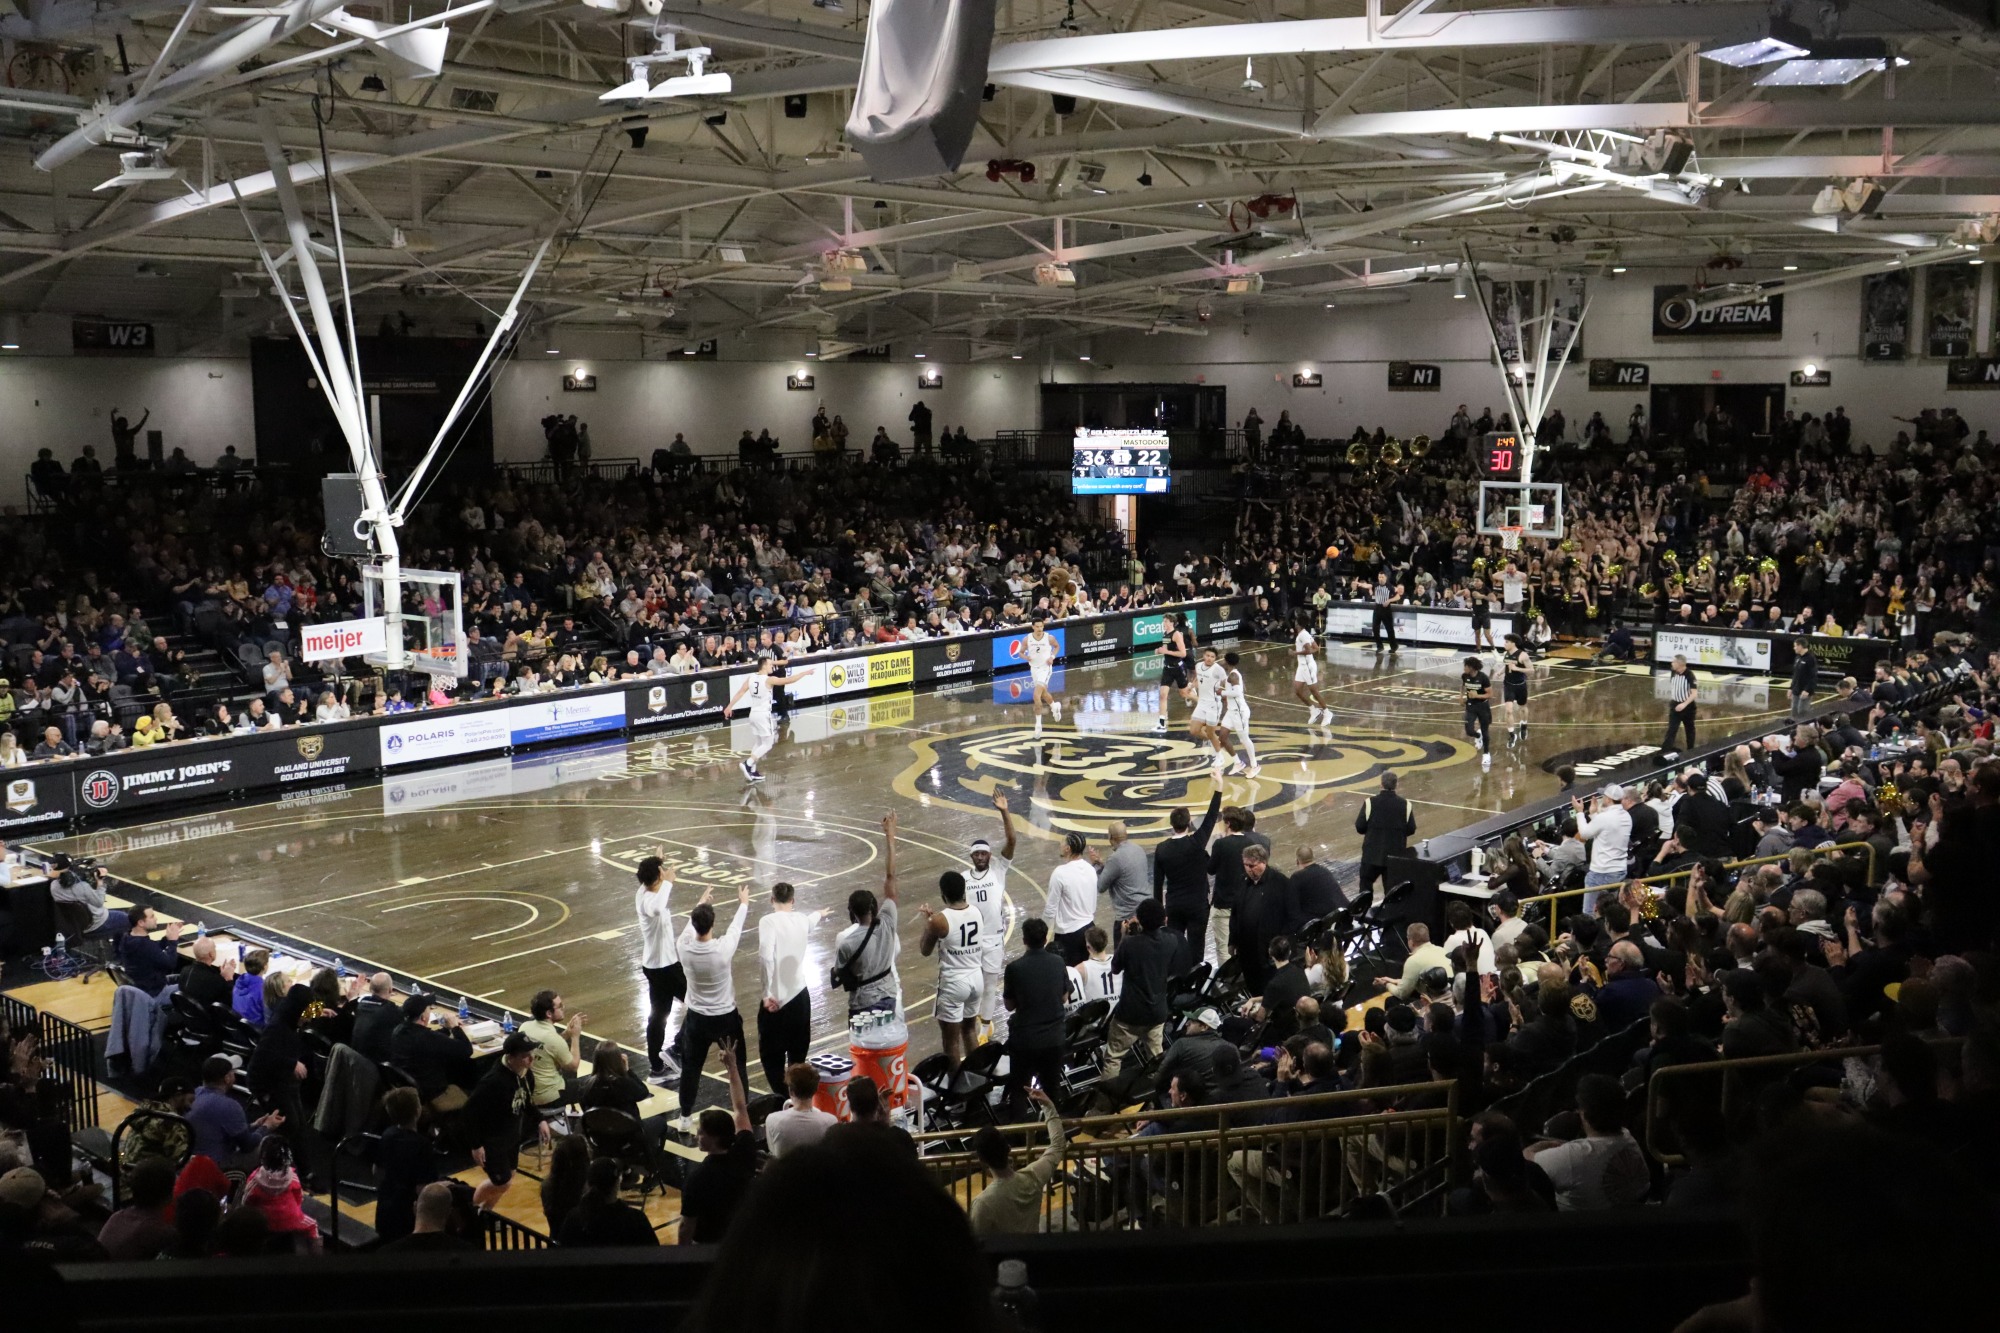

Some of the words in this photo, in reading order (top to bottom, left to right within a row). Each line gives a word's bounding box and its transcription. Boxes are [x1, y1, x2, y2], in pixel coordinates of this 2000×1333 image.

[108, 325, 147, 345] W3
[1502, 349, 1520, 361] 45
[1879, 343, 1891, 356] 5
[1945, 342, 1953, 355] 1
[1413, 369, 1434, 384] N1
[1617, 367, 1645, 383] N2
[1123, 439, 1168, 447] MASTODONS
[1496, 437, 1516, 447] 1:49
[1082, 450, 1107, 465] 36
[1119, 455, 1124, 463] 1
[1137, 450, 1161, 465] 22
[1490, 450, 1513, 472] 30
[1106, 466, 1136, 476] 01:50
[306, 629, 363, 653] meijer
[1659, 635, 1684, 643] STUDY
[1689, 637, 1714, 646] MORE.
[1674, 644, 1689, 652] PAY
[1694, 645, 1719, 654] LESS.
[870, 660, 888, 671] POST
[890, 656, 911, 668] GAME
[847, 668, 865, 678] WILD
[870, 667, 912, 680] HEADQUARTERS
[847, 676, 865, 685] WINGS
[753, 681, 759, 695] 3
[565, 705, 592, 715] Meemic
[408, 729, 455, 743] POLARIS
[274, 762, 309, 775] OAKLAND
[309, 756, 351, 769] UNIVERSITY
[123, 769, 176, 790] JIMMY
[179, 760, 231, 781] JOHN'S
[280, 770, 309, 782] GOLDEN
[309, 765, 346, 778] GRIZZLIES
[91, 780, 109, 800] JJ
[966, 882, 994, 891] OAKLAND
[975, 890, 987, 903] 10
[960, 921, 978, 947] 12
[1101, 971, 1114, 995] 11
[890, 1056, 904, 1076] G
